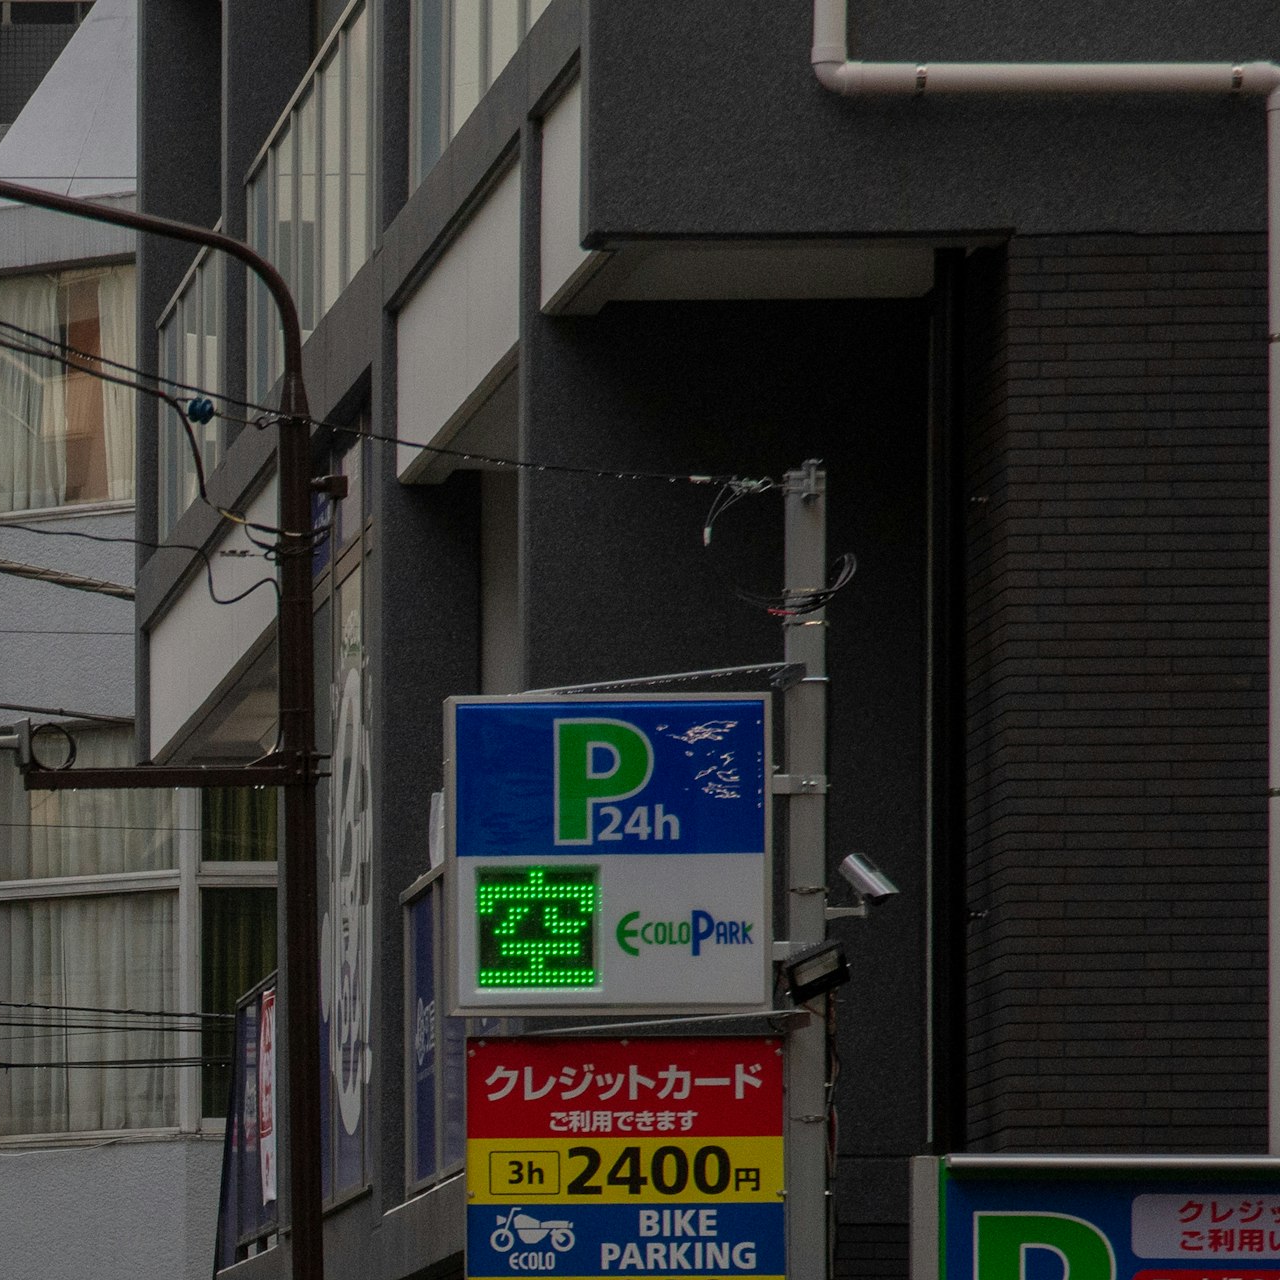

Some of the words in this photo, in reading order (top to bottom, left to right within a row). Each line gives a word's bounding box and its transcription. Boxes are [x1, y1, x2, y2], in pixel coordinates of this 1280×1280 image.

[553, 717, 655, 846] P
[597, 804, 680, 842] 24h
[478, 870, 596, 987] 空
[484, 1063, 763, 1101] クレジットカード
[548, 1110, 699, 1134] ご利用できます
[508, 1160, 544, 1185] 3h
[566, 1145, 761, 1195] 2400円
[639, 1209, 718, 1237] BIKE
[508, 1251, 556, 1271] ECOLO
[599, 1242, 757, 1270] PARKING
